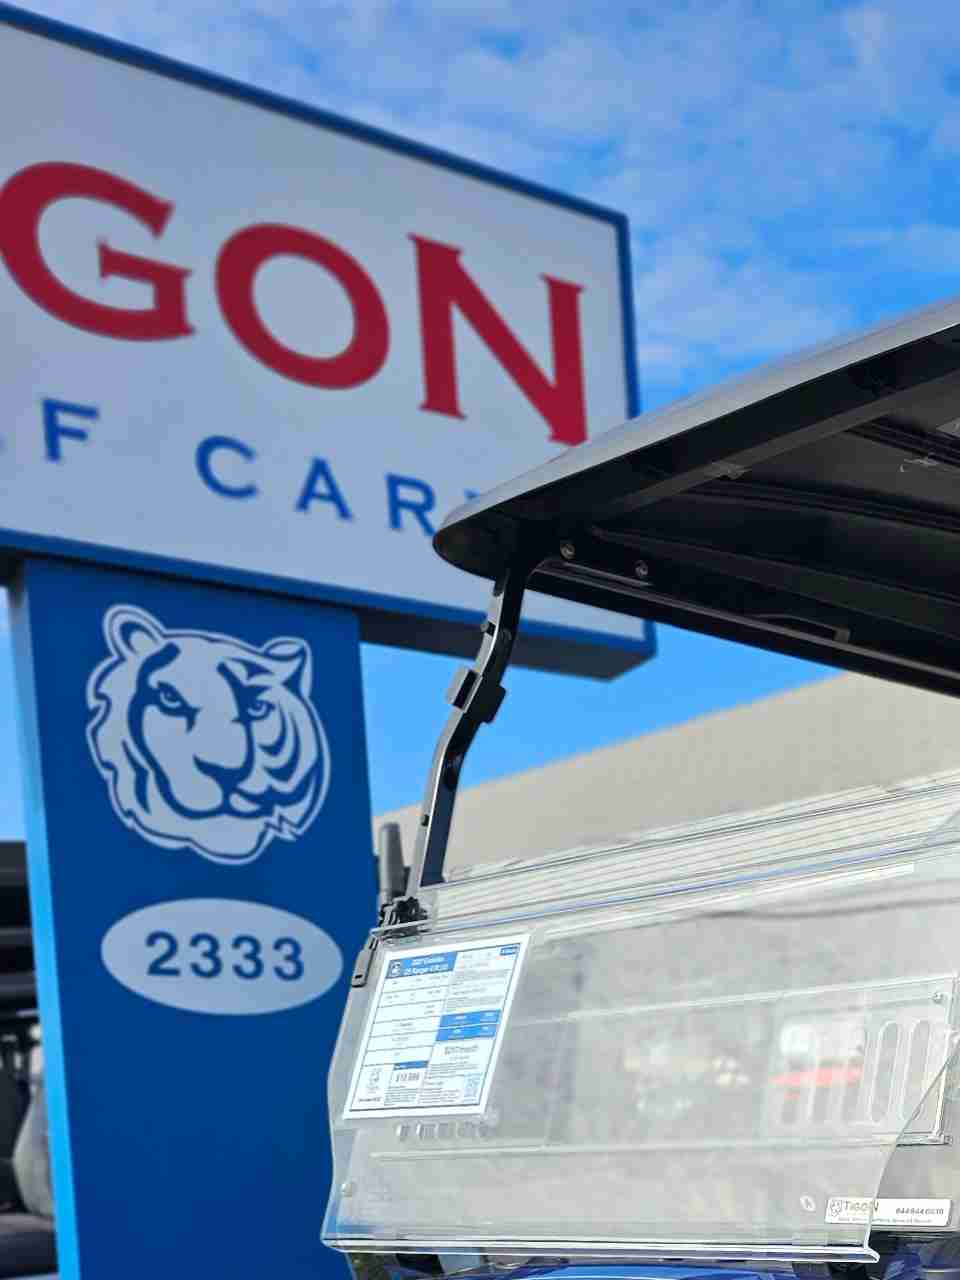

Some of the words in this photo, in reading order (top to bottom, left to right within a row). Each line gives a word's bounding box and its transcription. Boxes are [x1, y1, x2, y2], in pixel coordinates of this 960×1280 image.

[0, 161, 588, 447] GON
[195, 434, 480, 536] CAR
[145, 930, 305, 981] 2333
